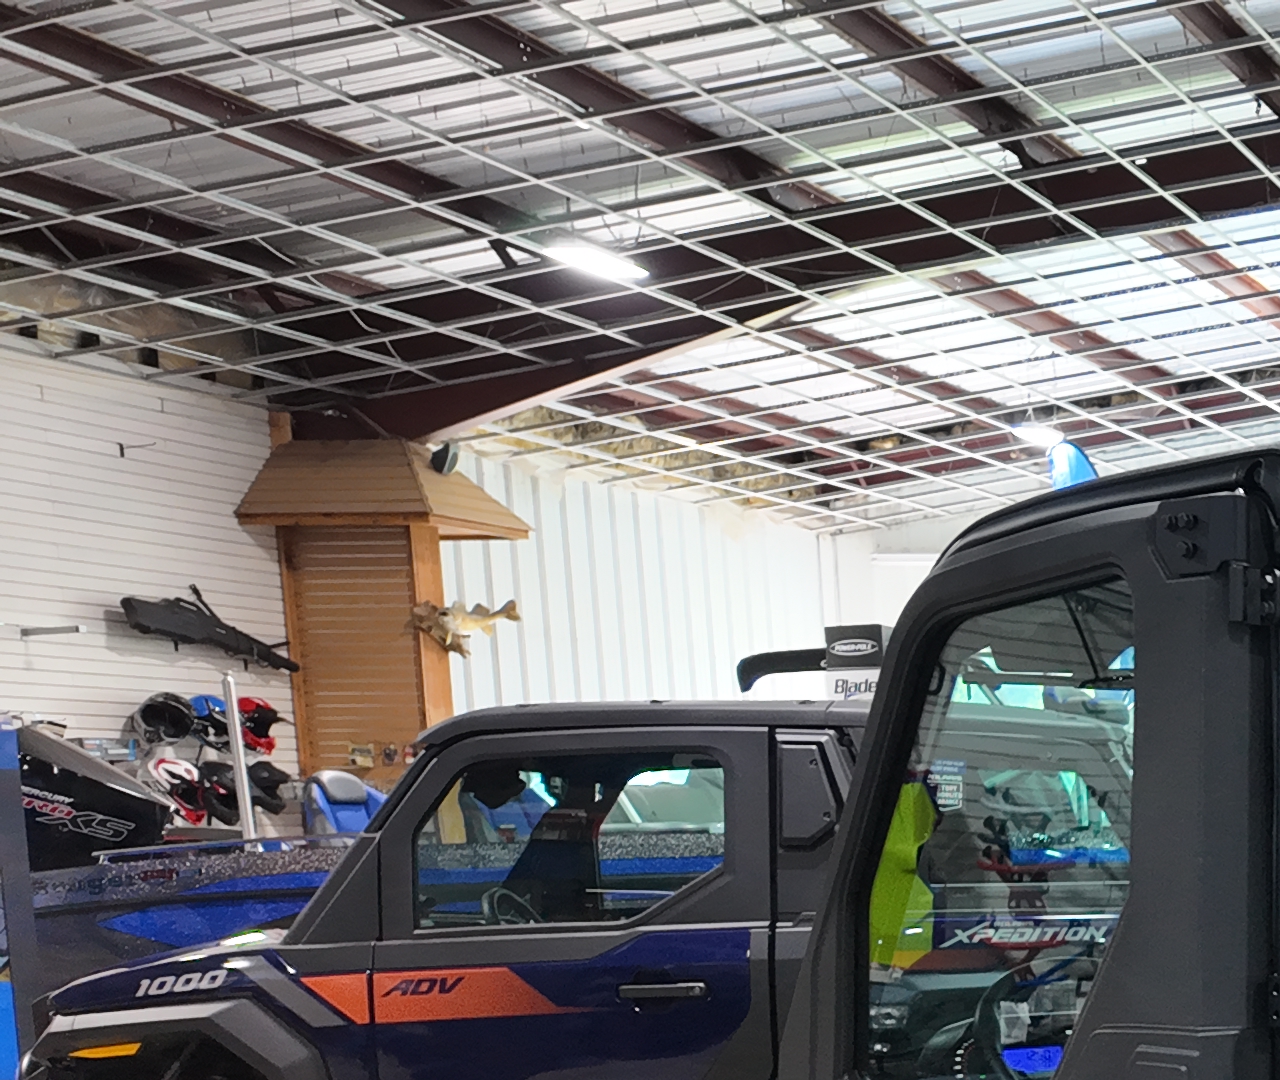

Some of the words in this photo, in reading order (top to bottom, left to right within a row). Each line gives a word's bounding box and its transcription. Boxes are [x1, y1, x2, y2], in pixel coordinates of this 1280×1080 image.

[834, 678, 878, 700] Blade
[938, 920, 1109, 949] XPEDITION
[134, 968, 229, 998] 1000
[380, 975, 466, 998] ADV
